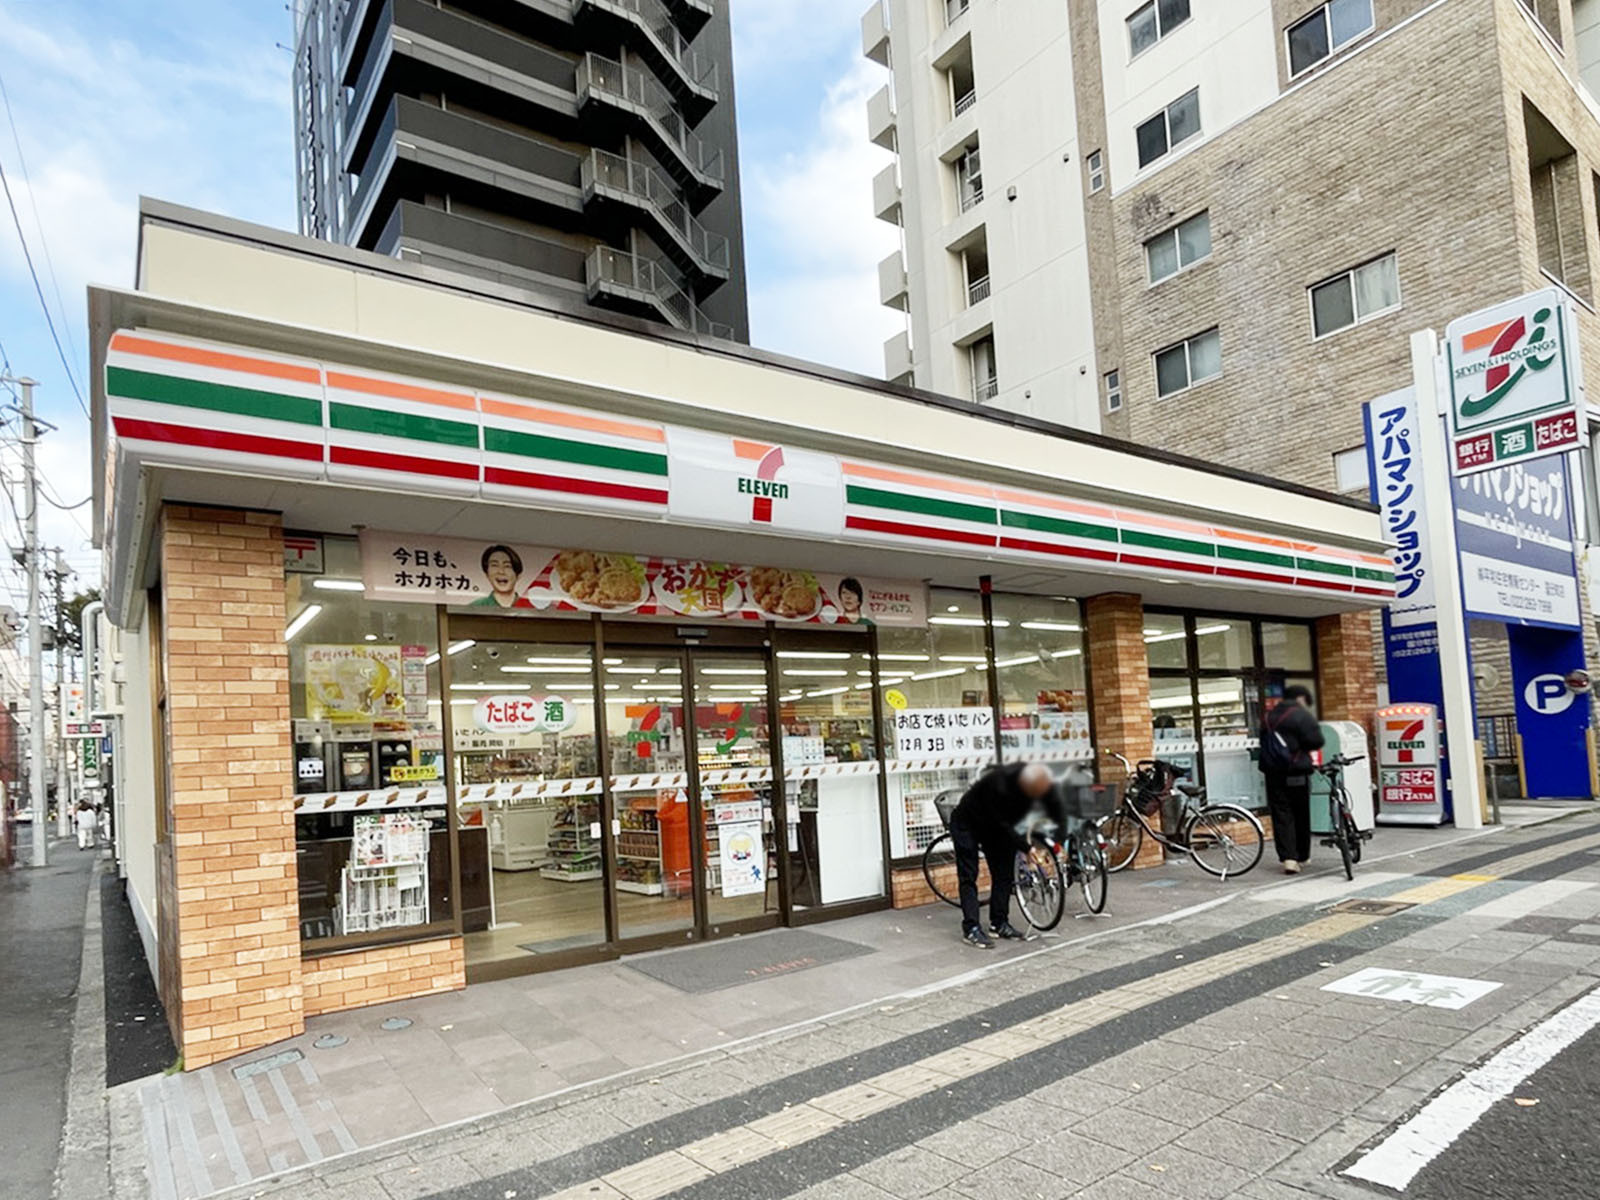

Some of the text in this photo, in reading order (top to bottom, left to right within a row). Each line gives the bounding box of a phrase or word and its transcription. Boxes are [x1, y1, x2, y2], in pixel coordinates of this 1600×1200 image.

[1501, 338, 1556, 363] HOLDINGS
[1501, 430, 1526, 454] 酒
[1537, 418, 1576, 446] たばこ
[1458, 439, 1491, 457] 銀行
[1464, 453, 1488, 464] ATM
[1379, 406, 1425, 598] アパマンショップ
[393, 547, 457, 569] 今日も、
[395, 571, 479, 592] ホカホカ。
[1535, 679, 1567, 709] P
[487, 701, 535, 722] たばこ
[544, 701, 564, 722] 酒
[1400, 771, 1434, 785] たばこ
